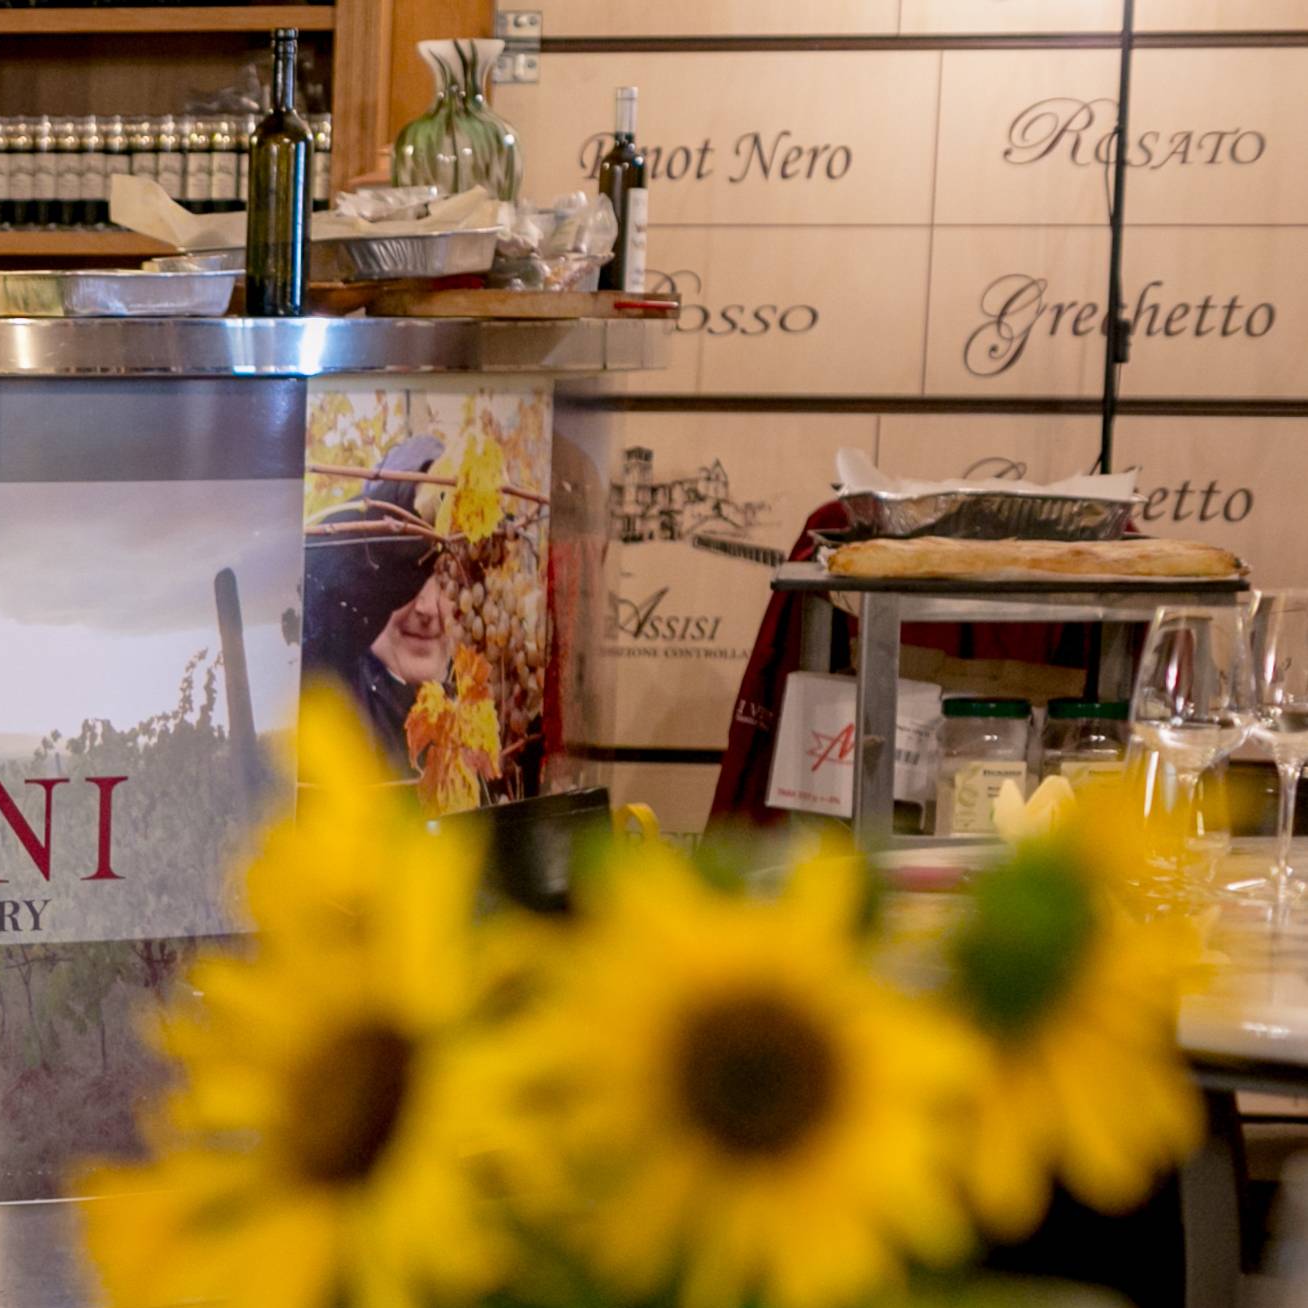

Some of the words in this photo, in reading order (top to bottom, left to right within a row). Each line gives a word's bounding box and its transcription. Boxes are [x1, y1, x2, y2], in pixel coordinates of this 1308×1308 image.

[579, 131, 715, 182] Pnot
[728, 130, 853, 183] Nero
[663, 646, 750, 659] CONTROLLA
